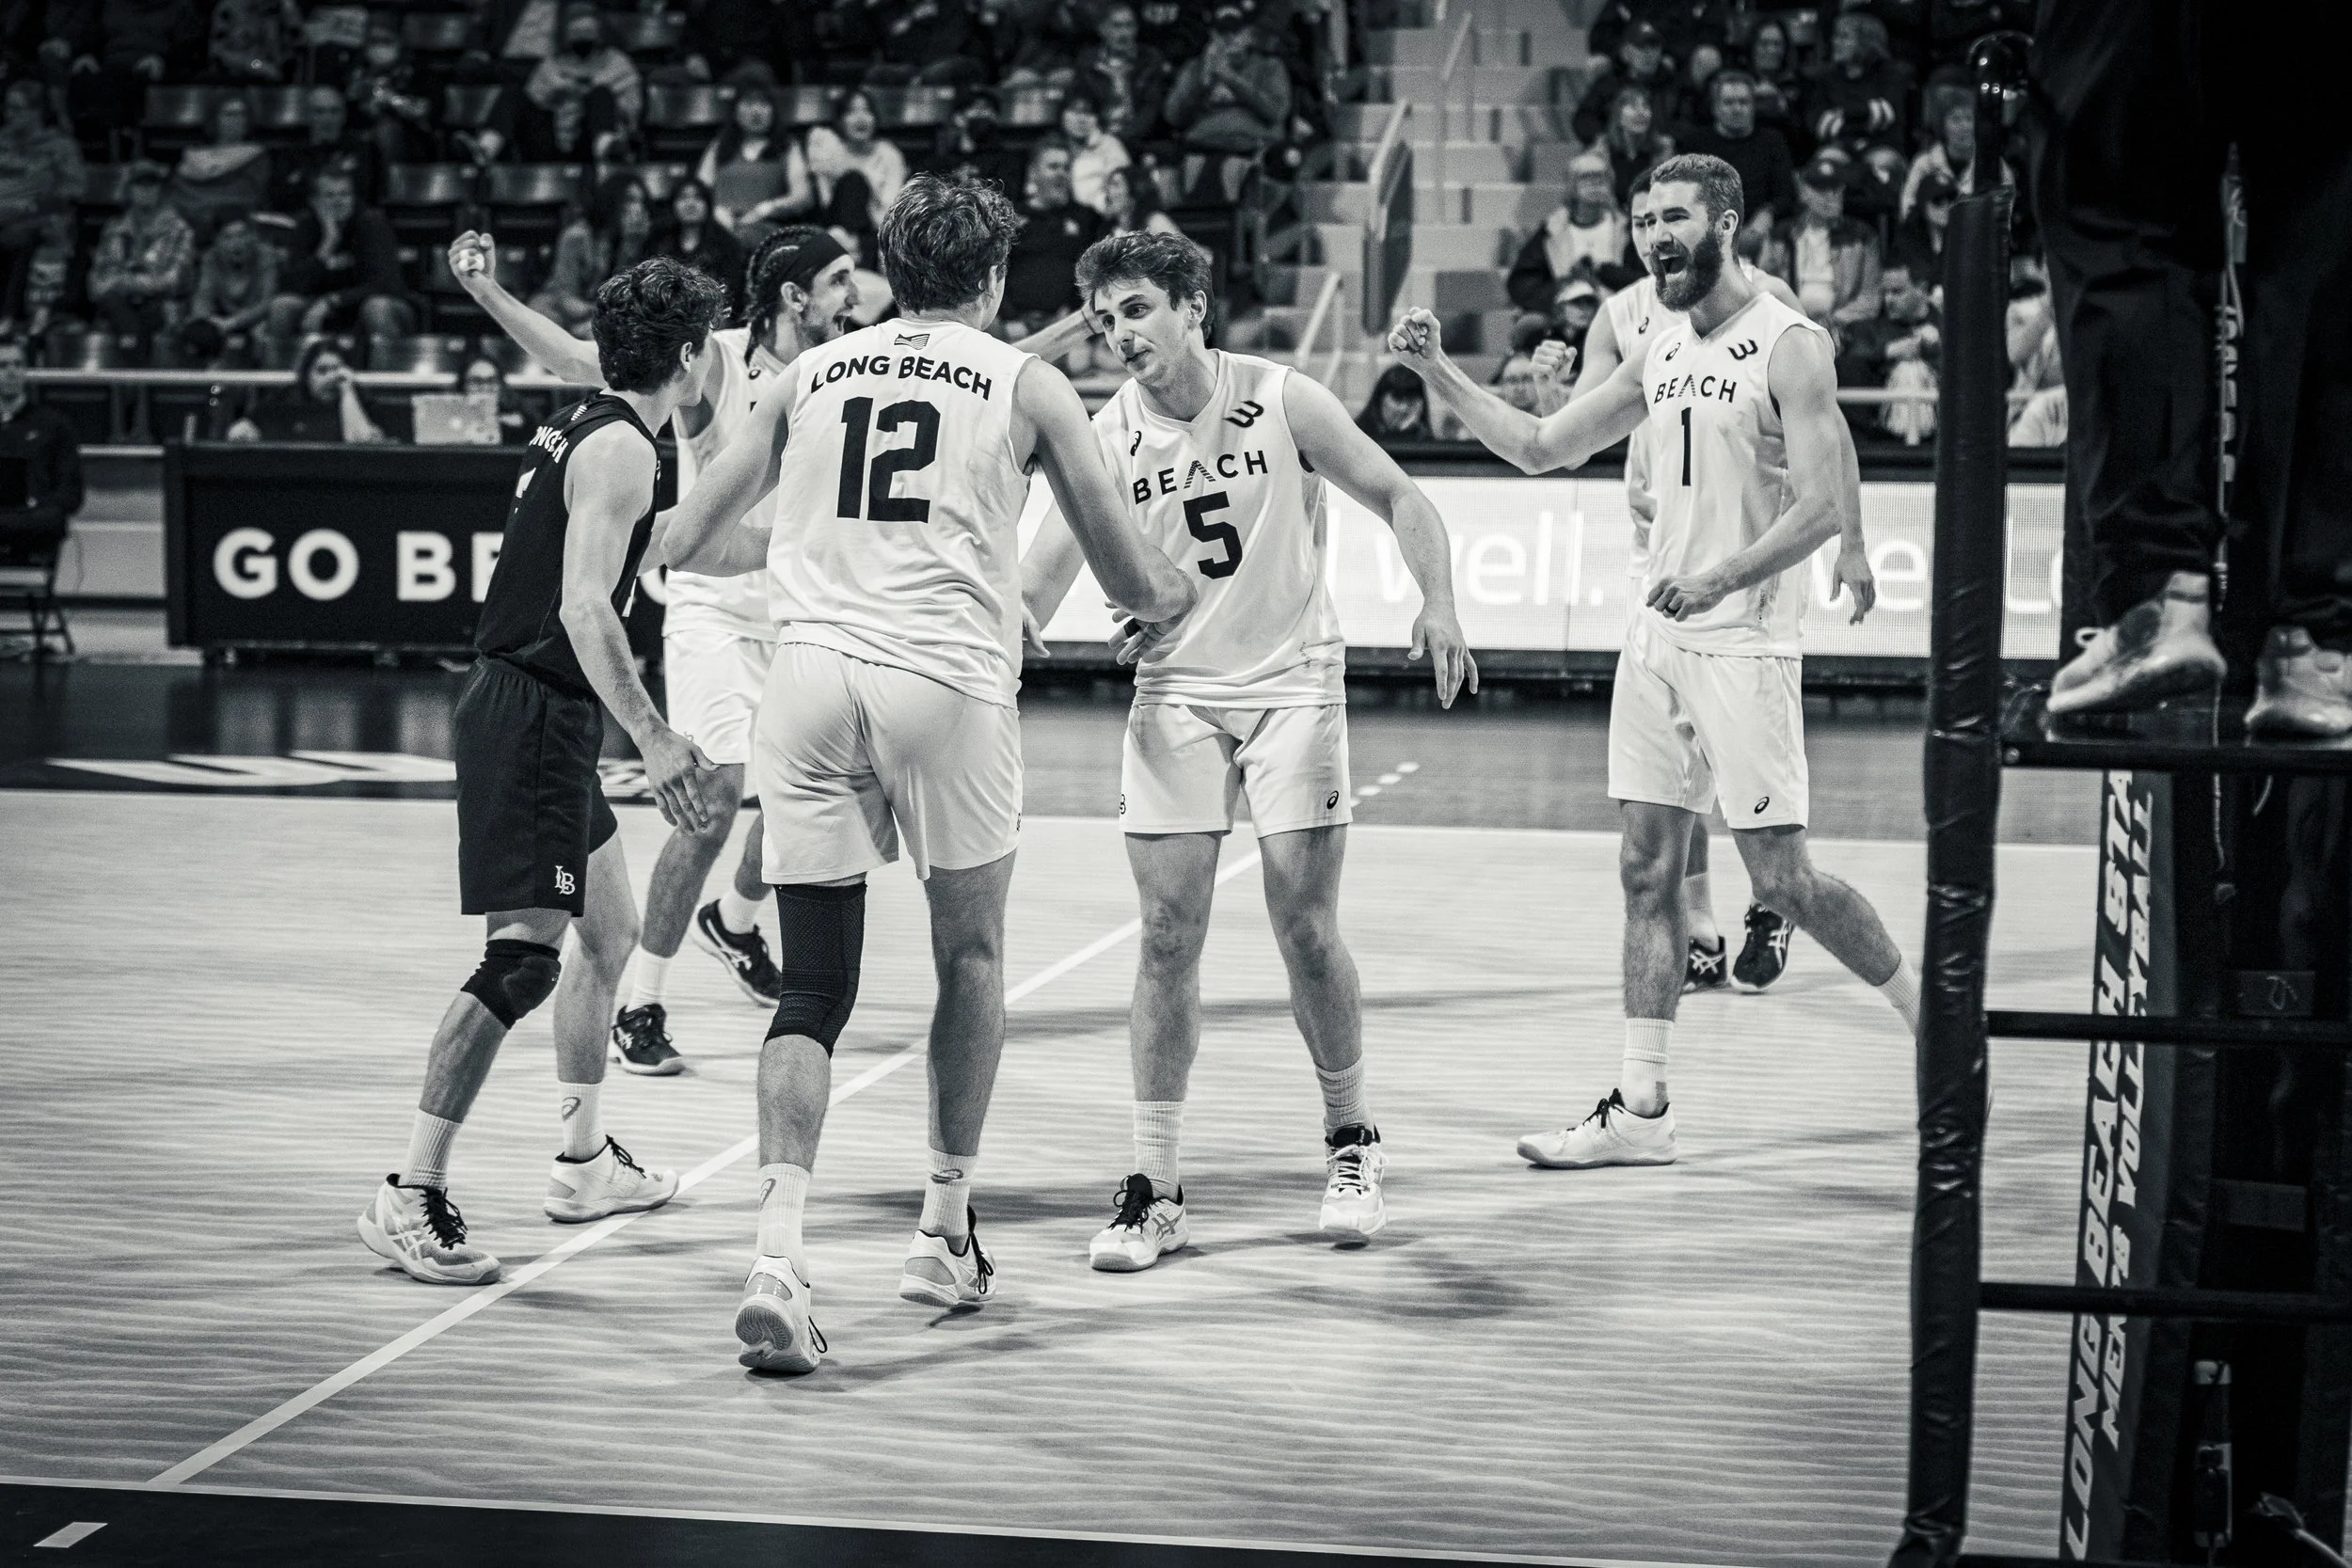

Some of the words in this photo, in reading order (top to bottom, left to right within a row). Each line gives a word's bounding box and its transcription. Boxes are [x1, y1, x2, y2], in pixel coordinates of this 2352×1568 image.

[810, 355, 892, 394] LONG
[897, 356, 993, 402] BEACH
[1653, 373, 1738, 405] BEACH
[836, 396, 942, 524] 12
[1132, 450, 1269, 506] BEACH
[1680, 406, 1692, 487] 1
[213, 526, 360, 600] GO
[1183, 490, 1244, 580] 5
[2104, 768, 2134, 937] STA
[2117, 790, 2153, 1209] VOLLYBALL
[2083, 953, 2126, 1288] BEACH
[2065, 1313, 2102, 1562] LONG
